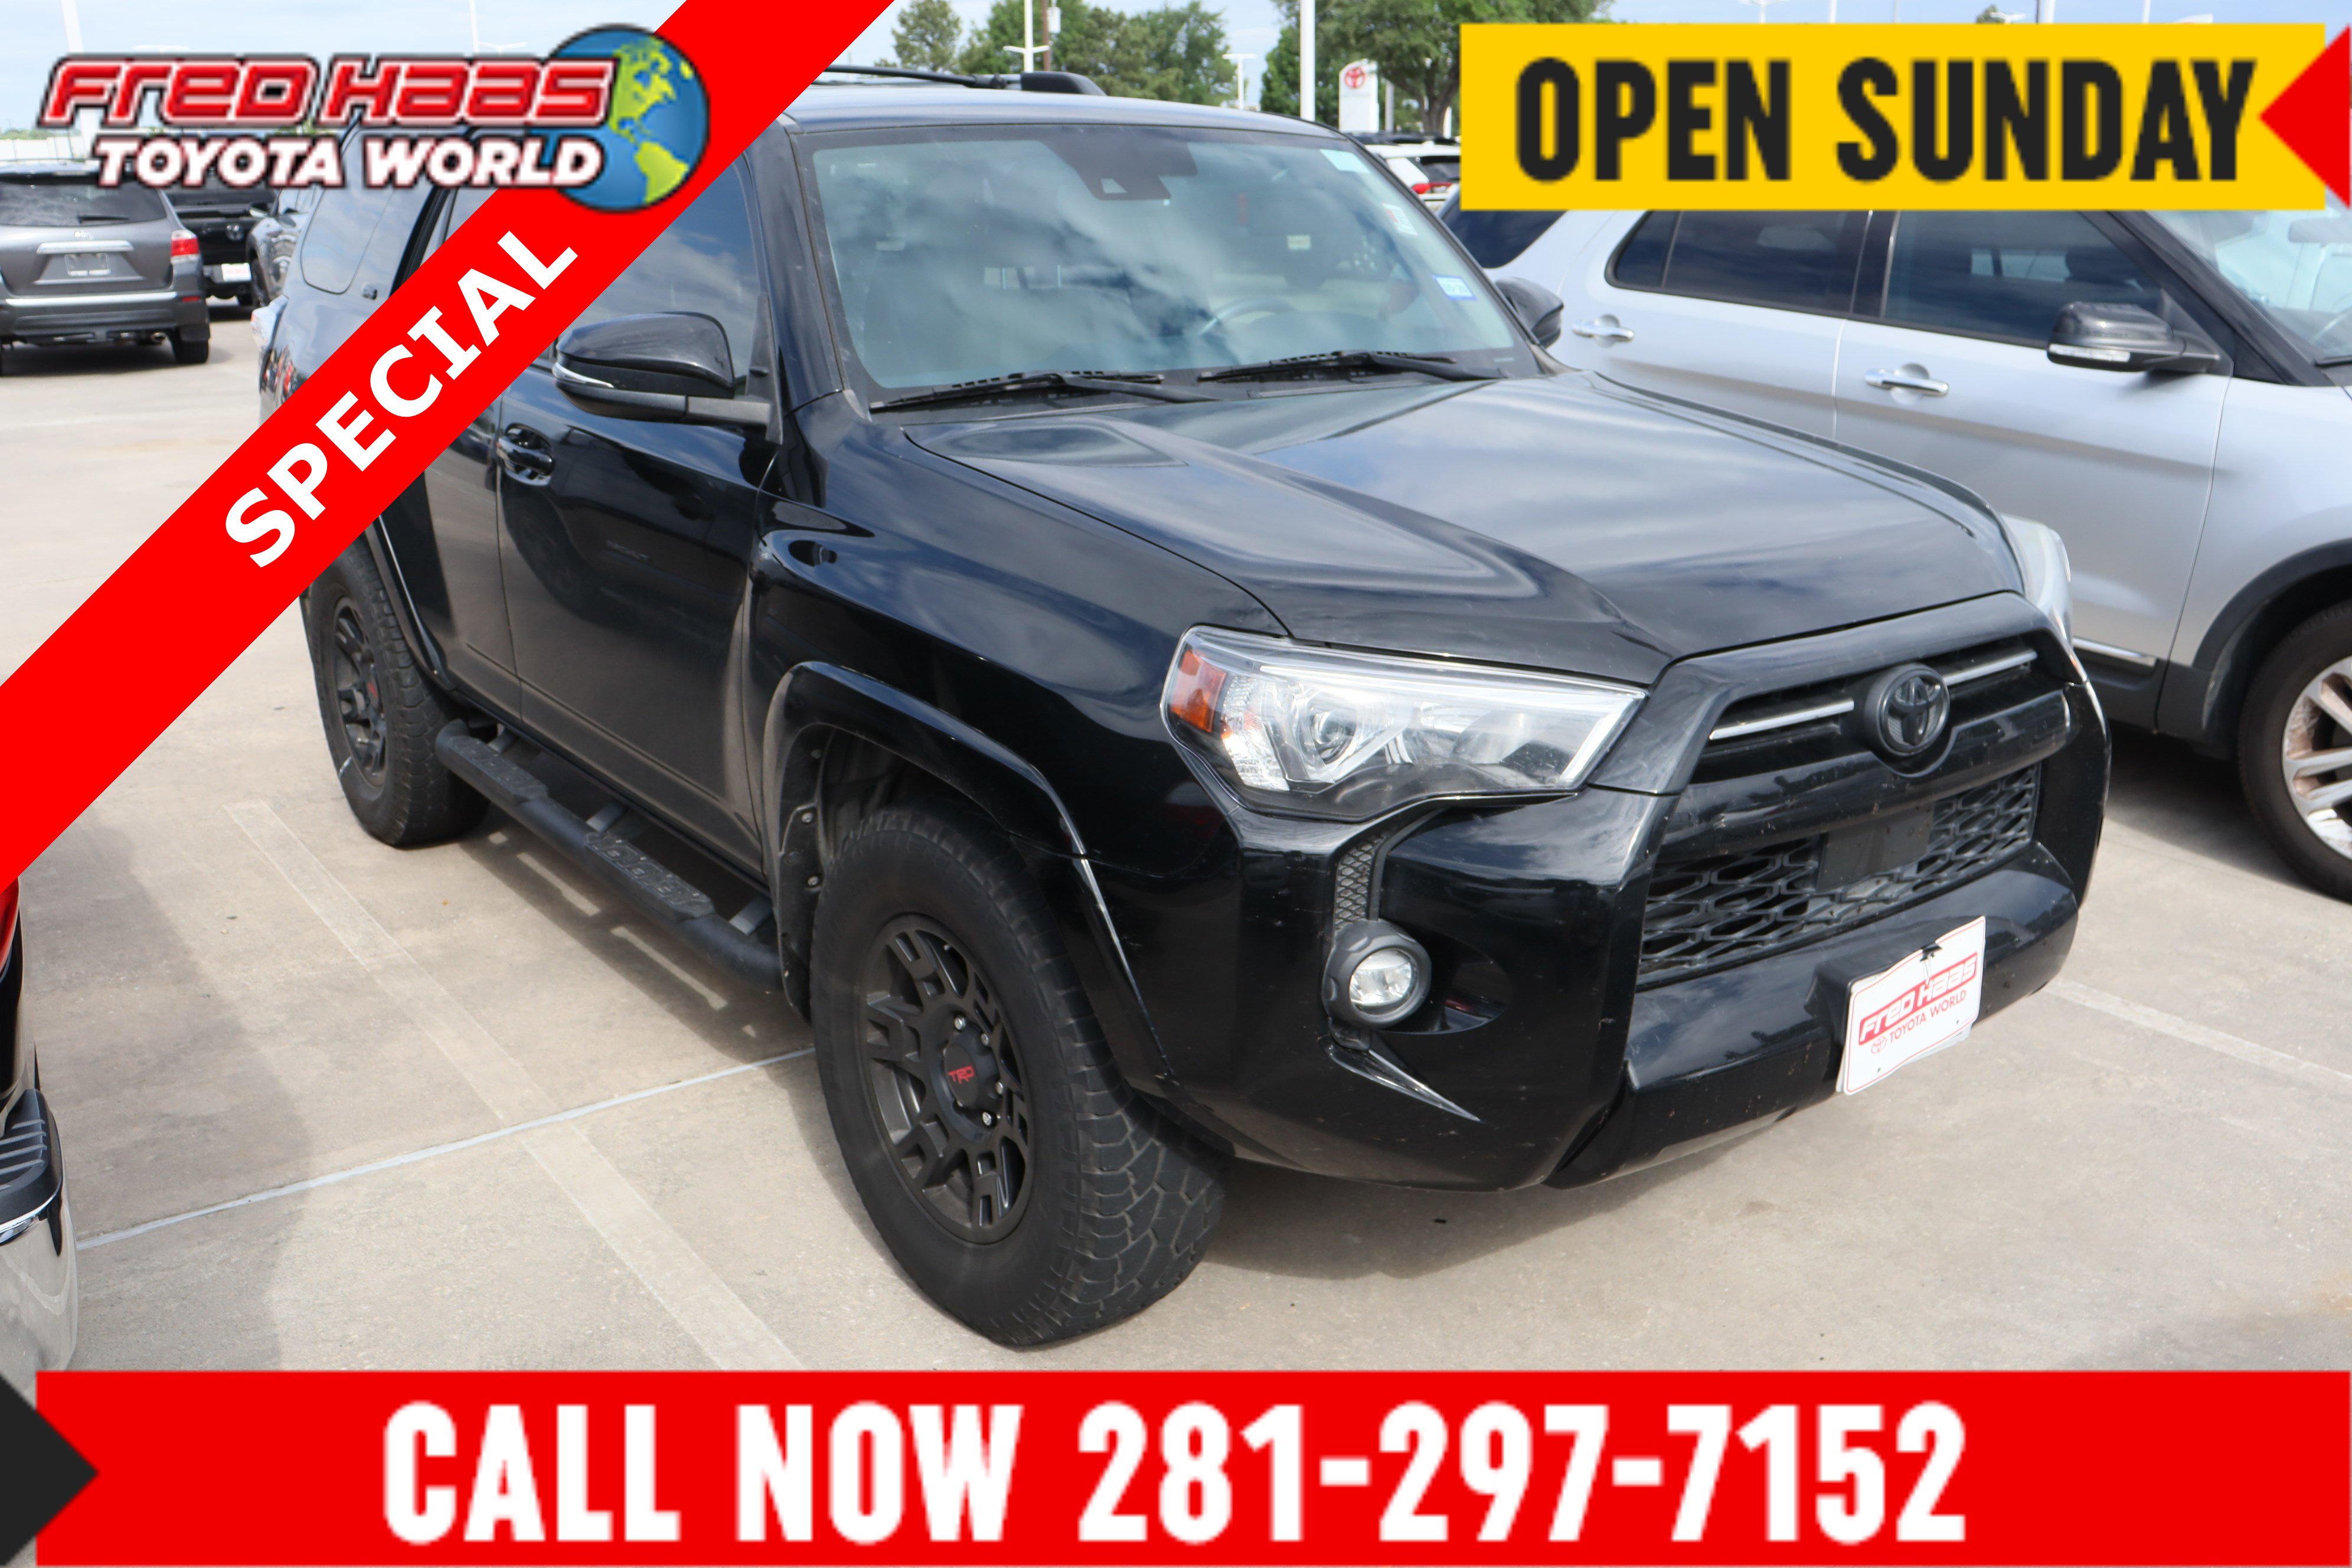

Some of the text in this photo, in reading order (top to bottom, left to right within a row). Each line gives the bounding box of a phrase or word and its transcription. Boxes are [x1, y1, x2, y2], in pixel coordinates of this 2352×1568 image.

[1890, 989, 1966, 1043] TOYOTA WORLD
[948, 1066, 974, 1084] TRD
